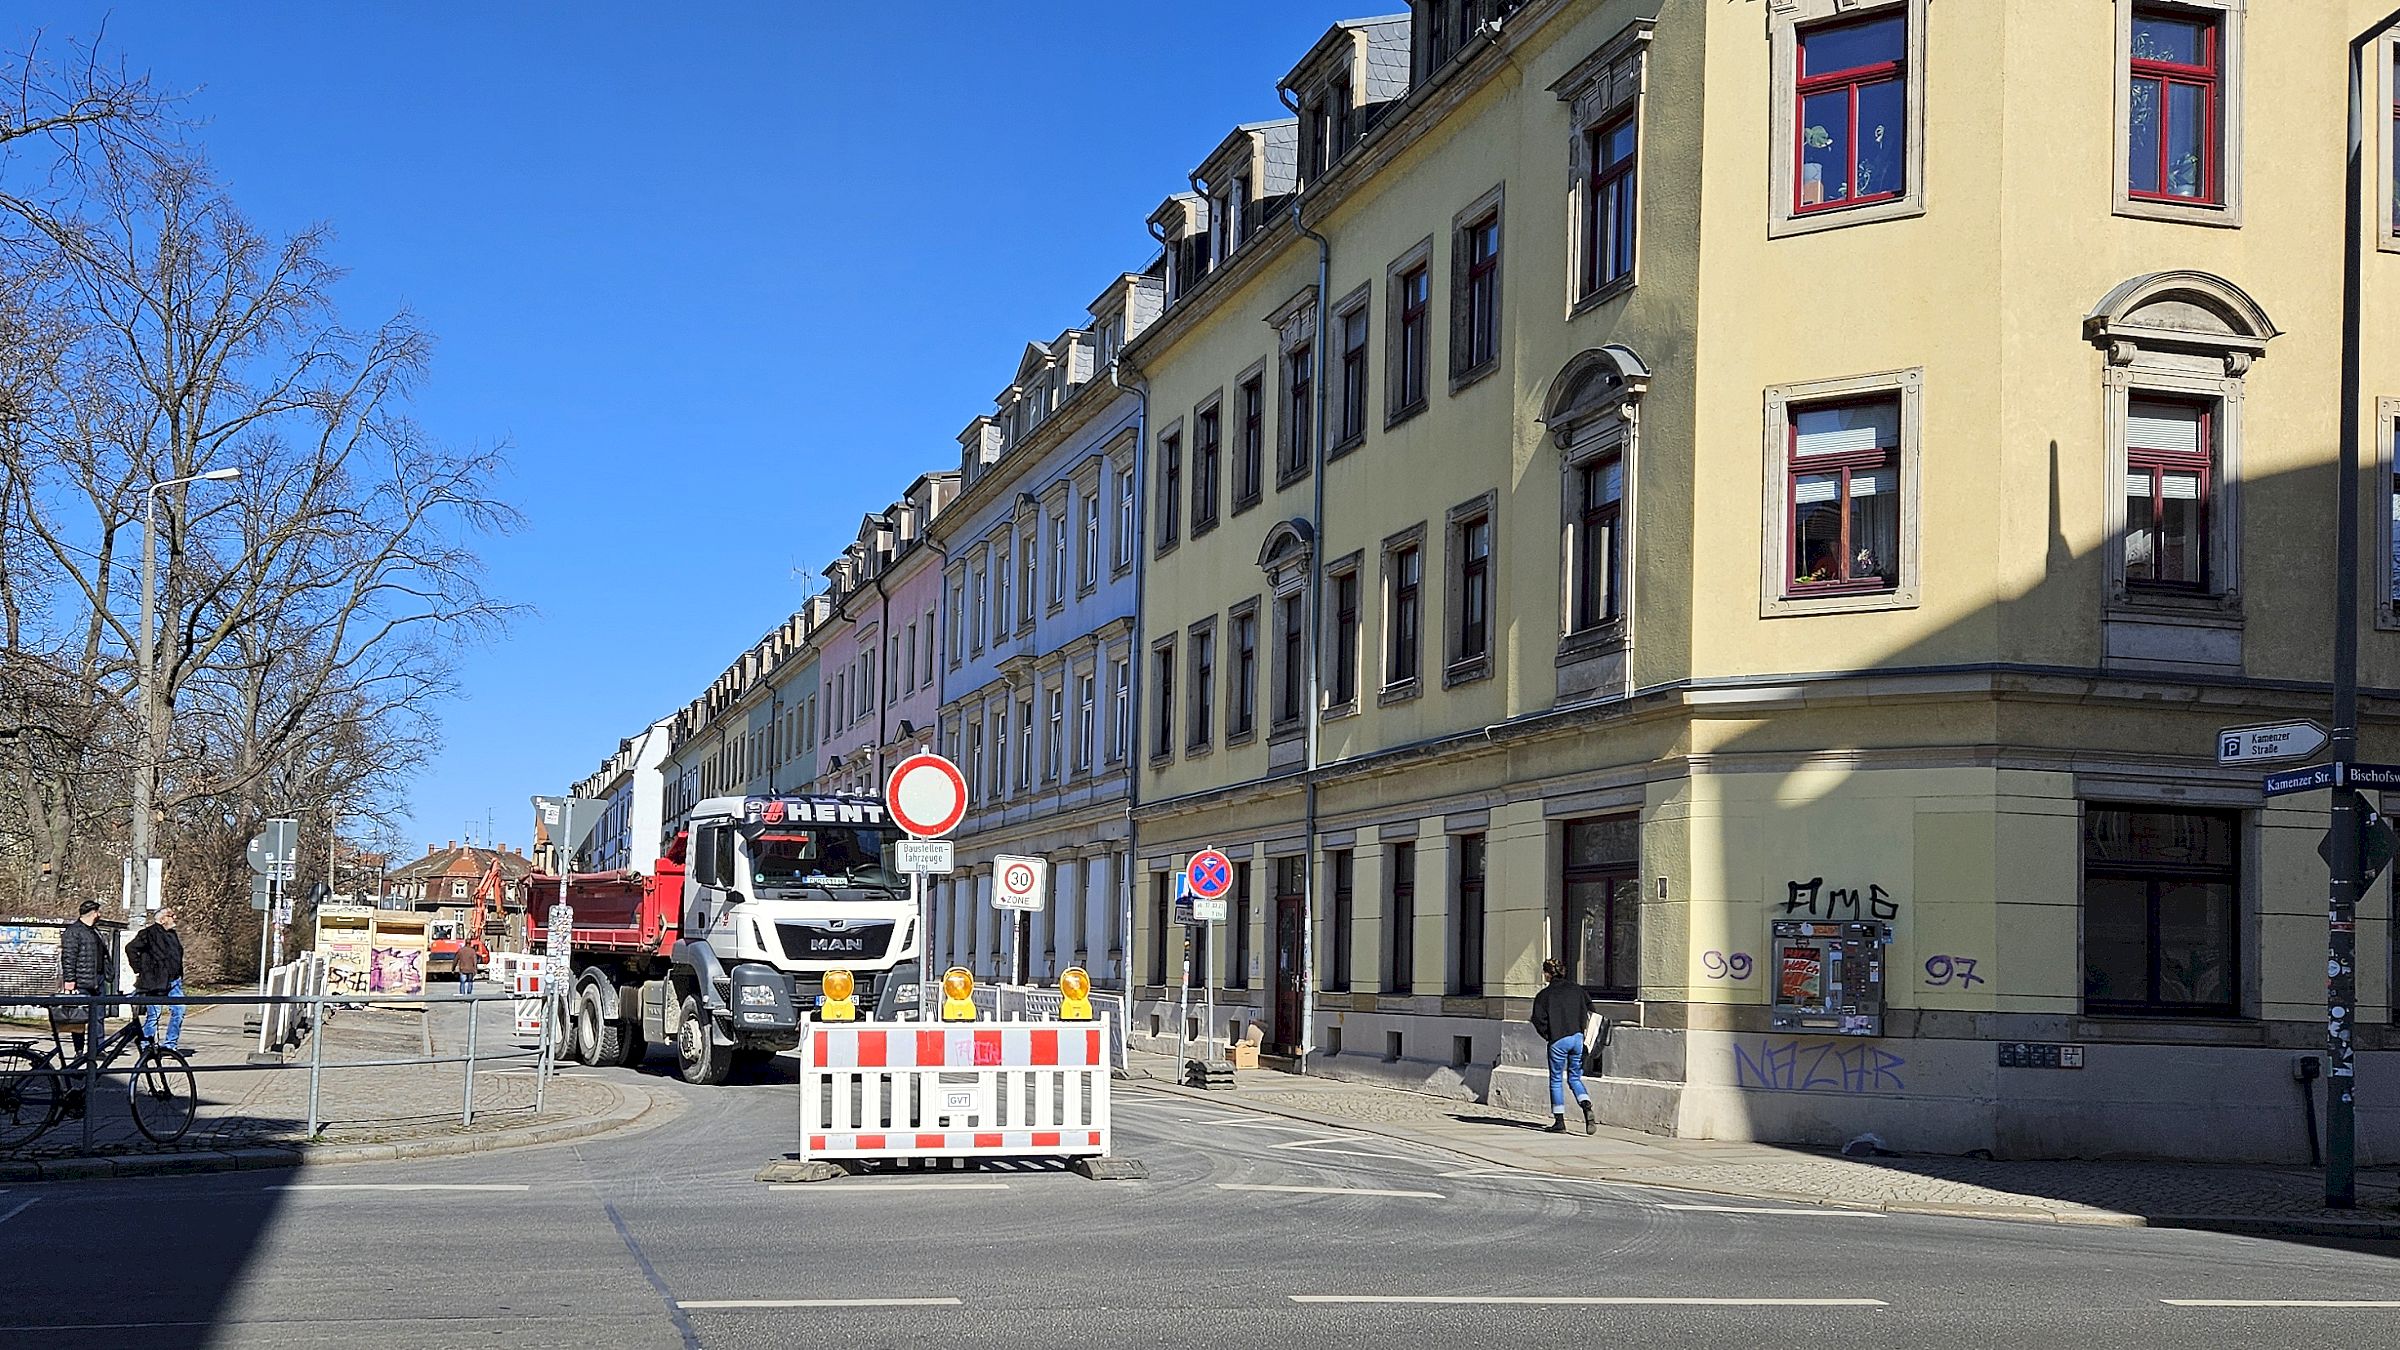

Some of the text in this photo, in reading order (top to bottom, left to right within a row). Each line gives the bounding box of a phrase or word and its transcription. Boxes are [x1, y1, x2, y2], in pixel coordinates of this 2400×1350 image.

[2252, 732, 2291, 744] Kamenzer
[2252, 745, 2279, 755] Straße
[2267, 771, 2331, 792] Kamenzer Str.
[787, 803, 884, 823] HENT
[903, 843, 949, 853] Baustellen-
[905, 853, 943, 864] fahrzeuge
[1010, 871, 1029, 887] 30
[1006, 895, 1031, 906] ZONE
[810, 938, 863, 951] MAN
[1703, 950, 1753, 980] 99
[1925, 954, 1985, 989] 97
[1733, 1039, 1906, 1093] NAZAR
[950, 1096, 969, 1105] GVT
